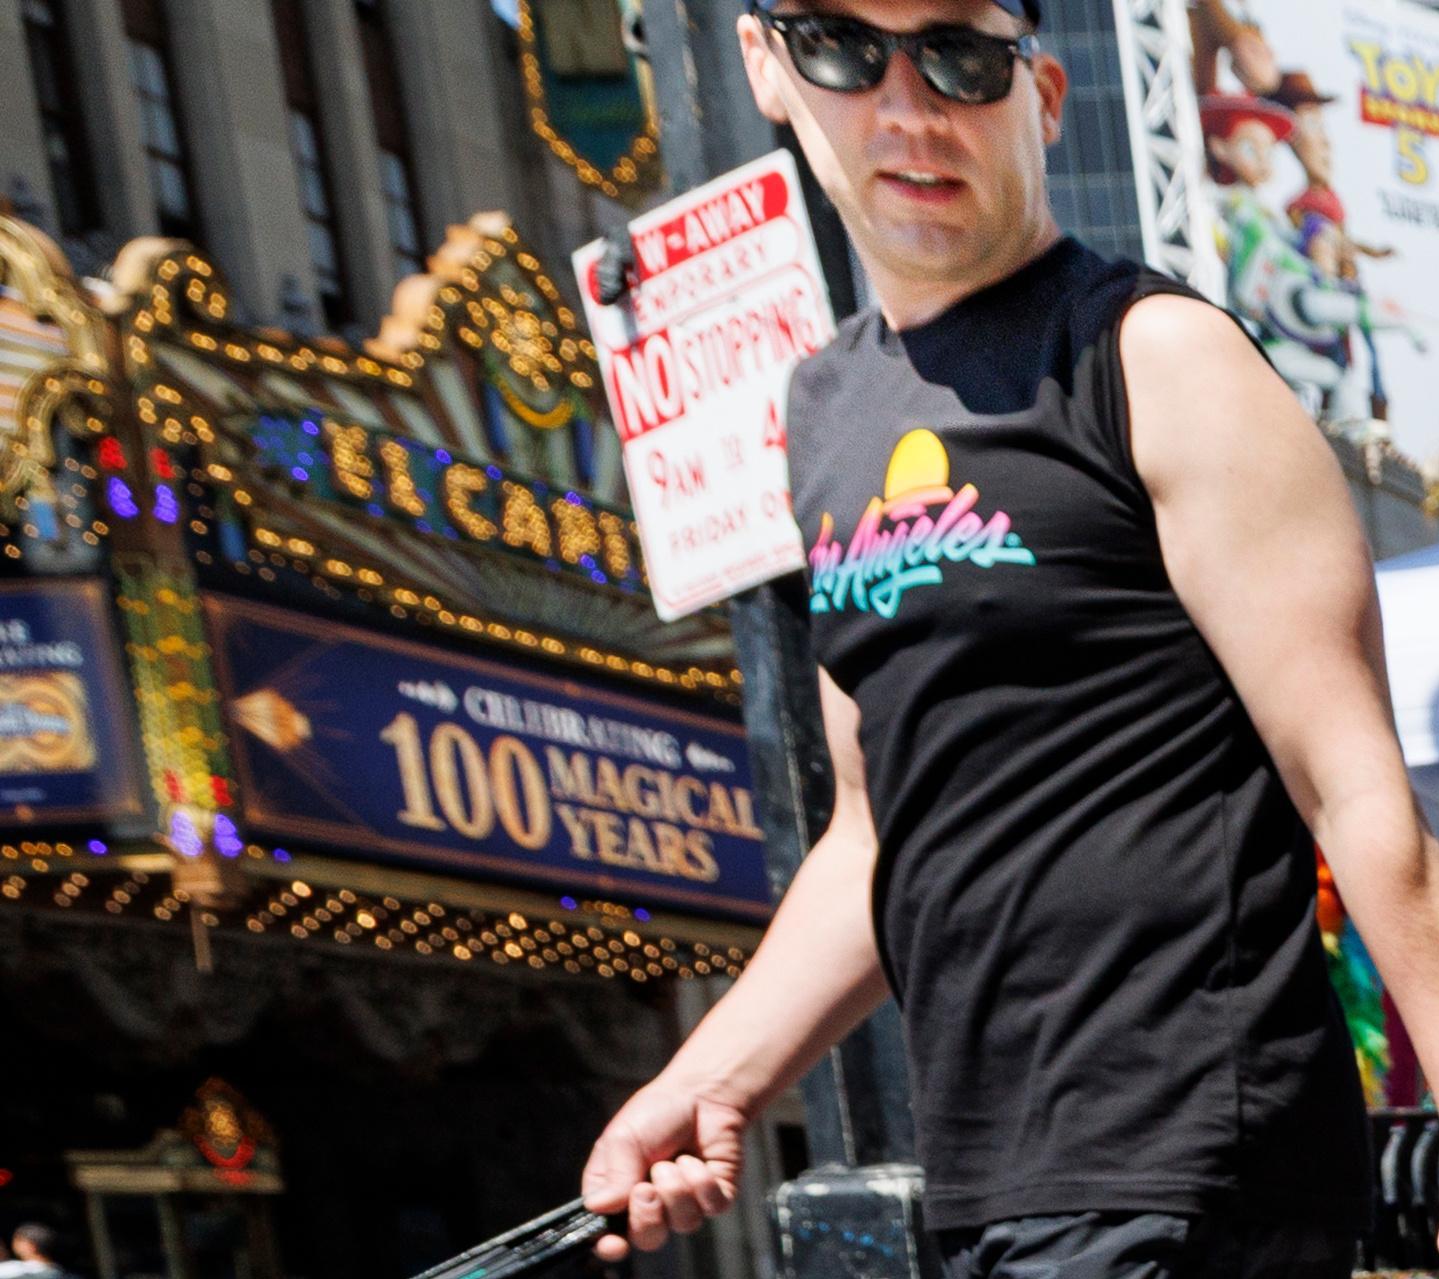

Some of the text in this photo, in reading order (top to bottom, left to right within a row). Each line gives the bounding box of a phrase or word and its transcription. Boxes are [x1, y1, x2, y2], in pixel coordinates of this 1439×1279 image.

[634, 237, 768, 322] EMPORARY
[614, 287, 817, 437] NO STOPPING
[324, 420, 425, 517] EL
[464, 686, 682, 769] CELEBRATING
[382, 713, 765, 851] 100 MAGICAL
[556, 803, 719, 883] YEARS
